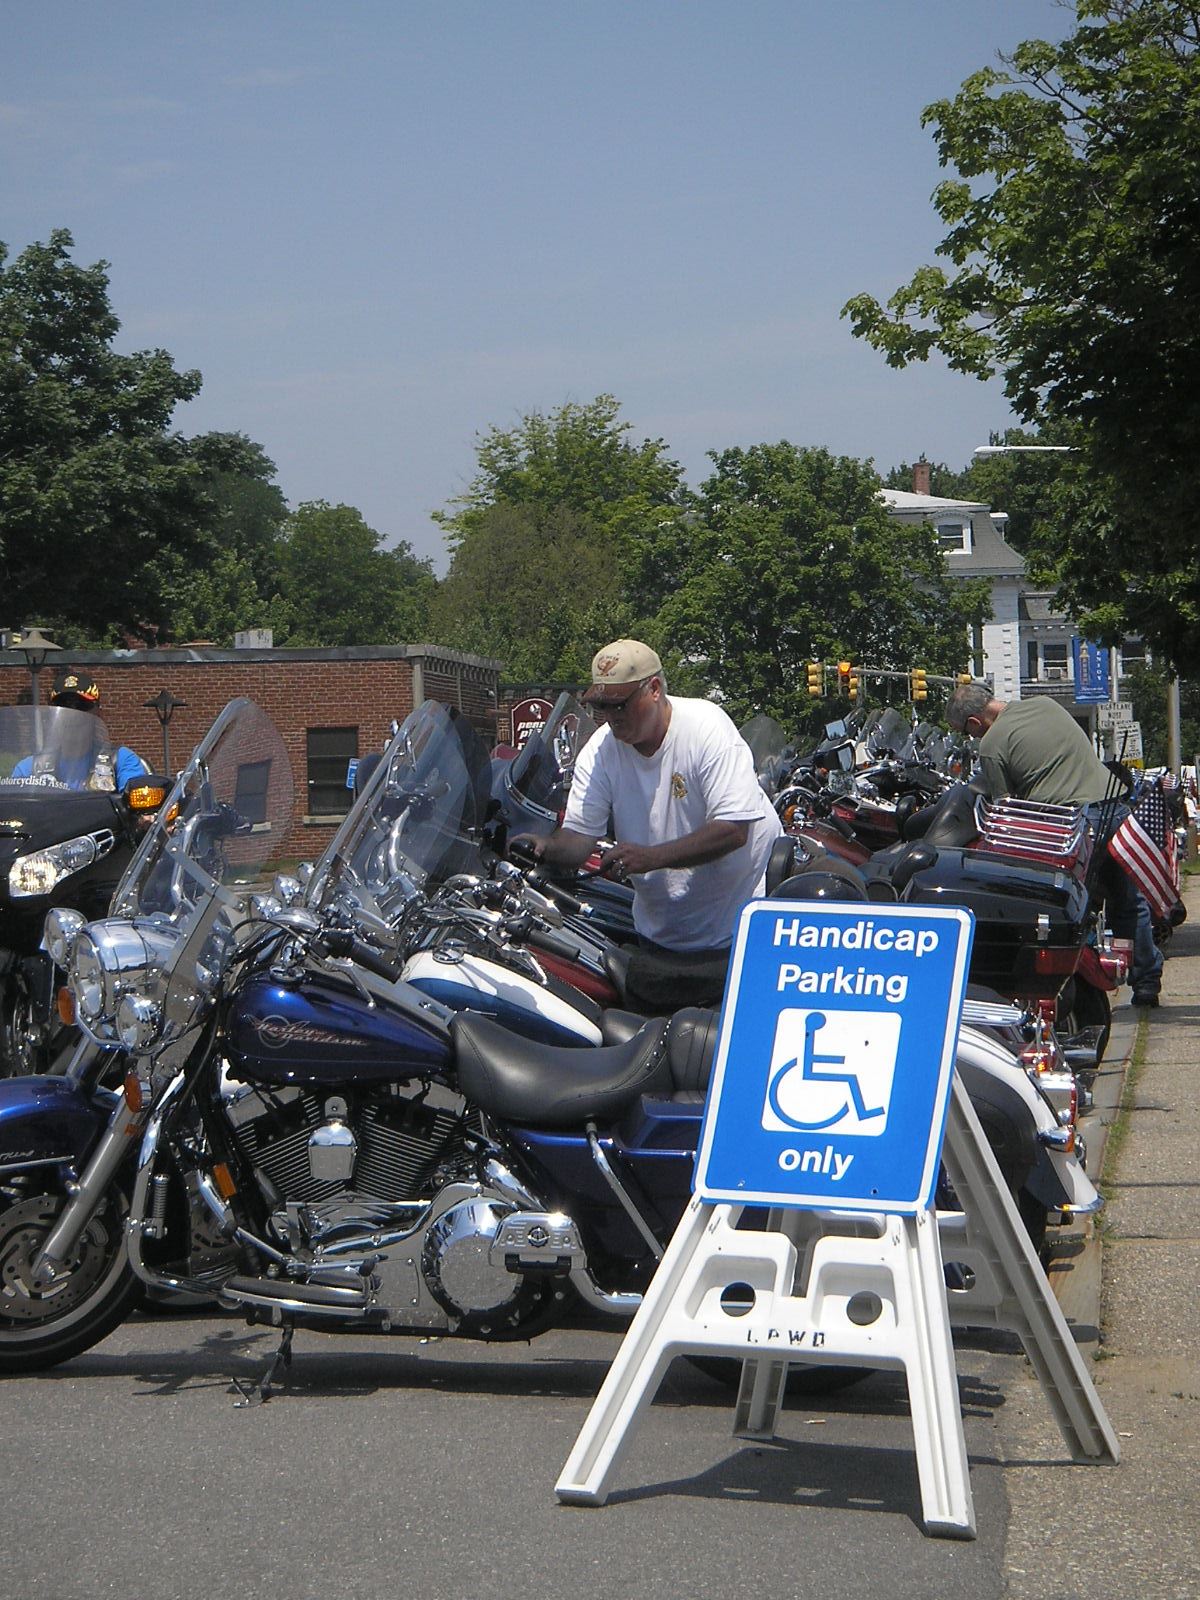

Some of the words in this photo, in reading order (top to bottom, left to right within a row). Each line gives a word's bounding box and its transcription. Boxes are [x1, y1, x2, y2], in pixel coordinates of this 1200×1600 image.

[773, 918, 939, 957] Handicap
[777, 963, 909, 1003] Parking
[778, 1145, 854, 1180] only
